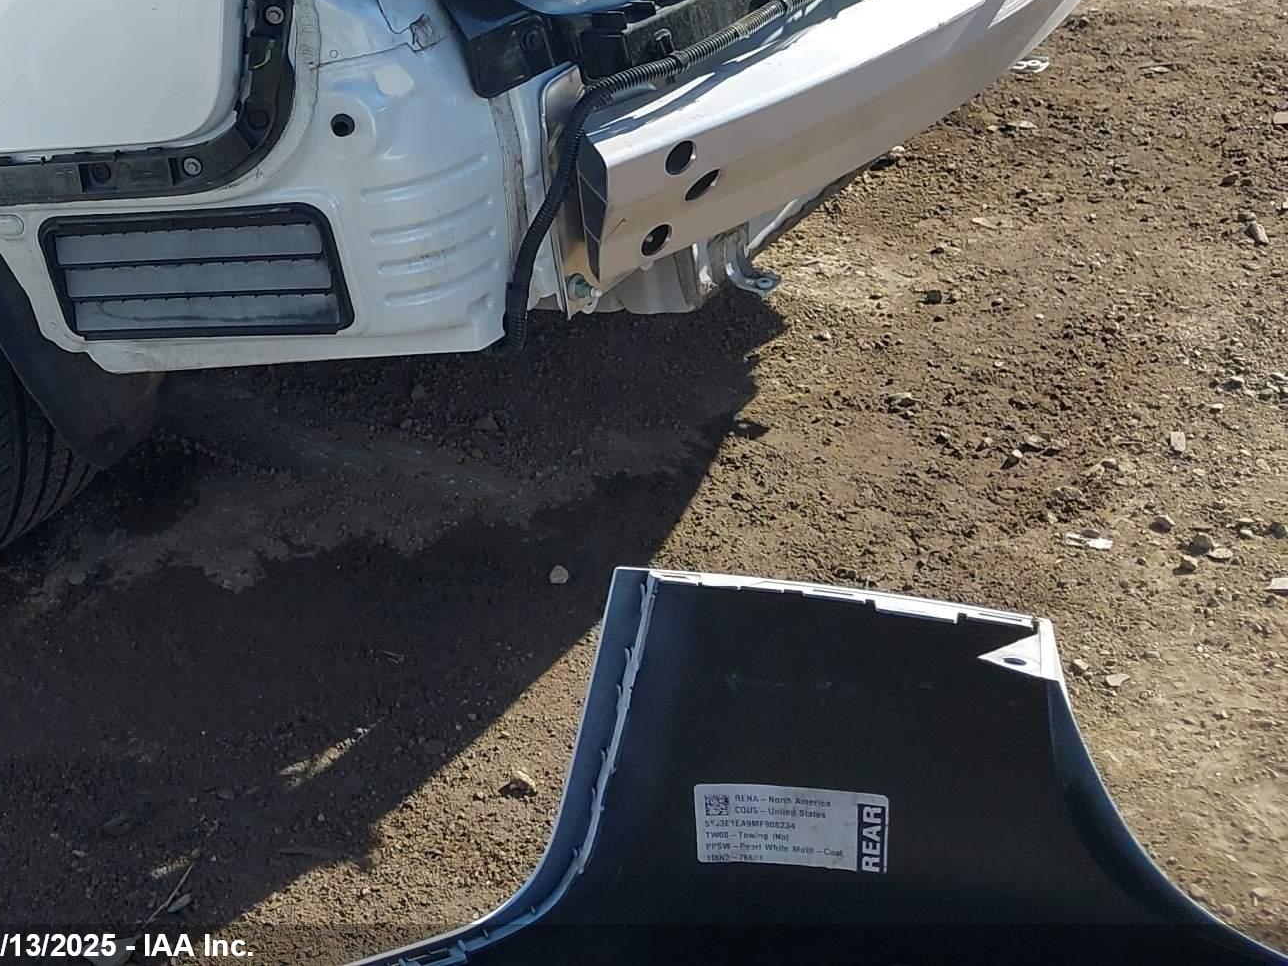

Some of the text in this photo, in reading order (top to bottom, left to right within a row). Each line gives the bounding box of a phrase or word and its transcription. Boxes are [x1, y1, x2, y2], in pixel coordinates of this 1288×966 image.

[795, 797, 832, 807] America
[768, 807, 797, 818] United
[799, 810, 827, 819] States
[861, 805, 883, 873] REAR
[740, 842, 763, 851] Pearl
[765, 843, 790, 853] White
